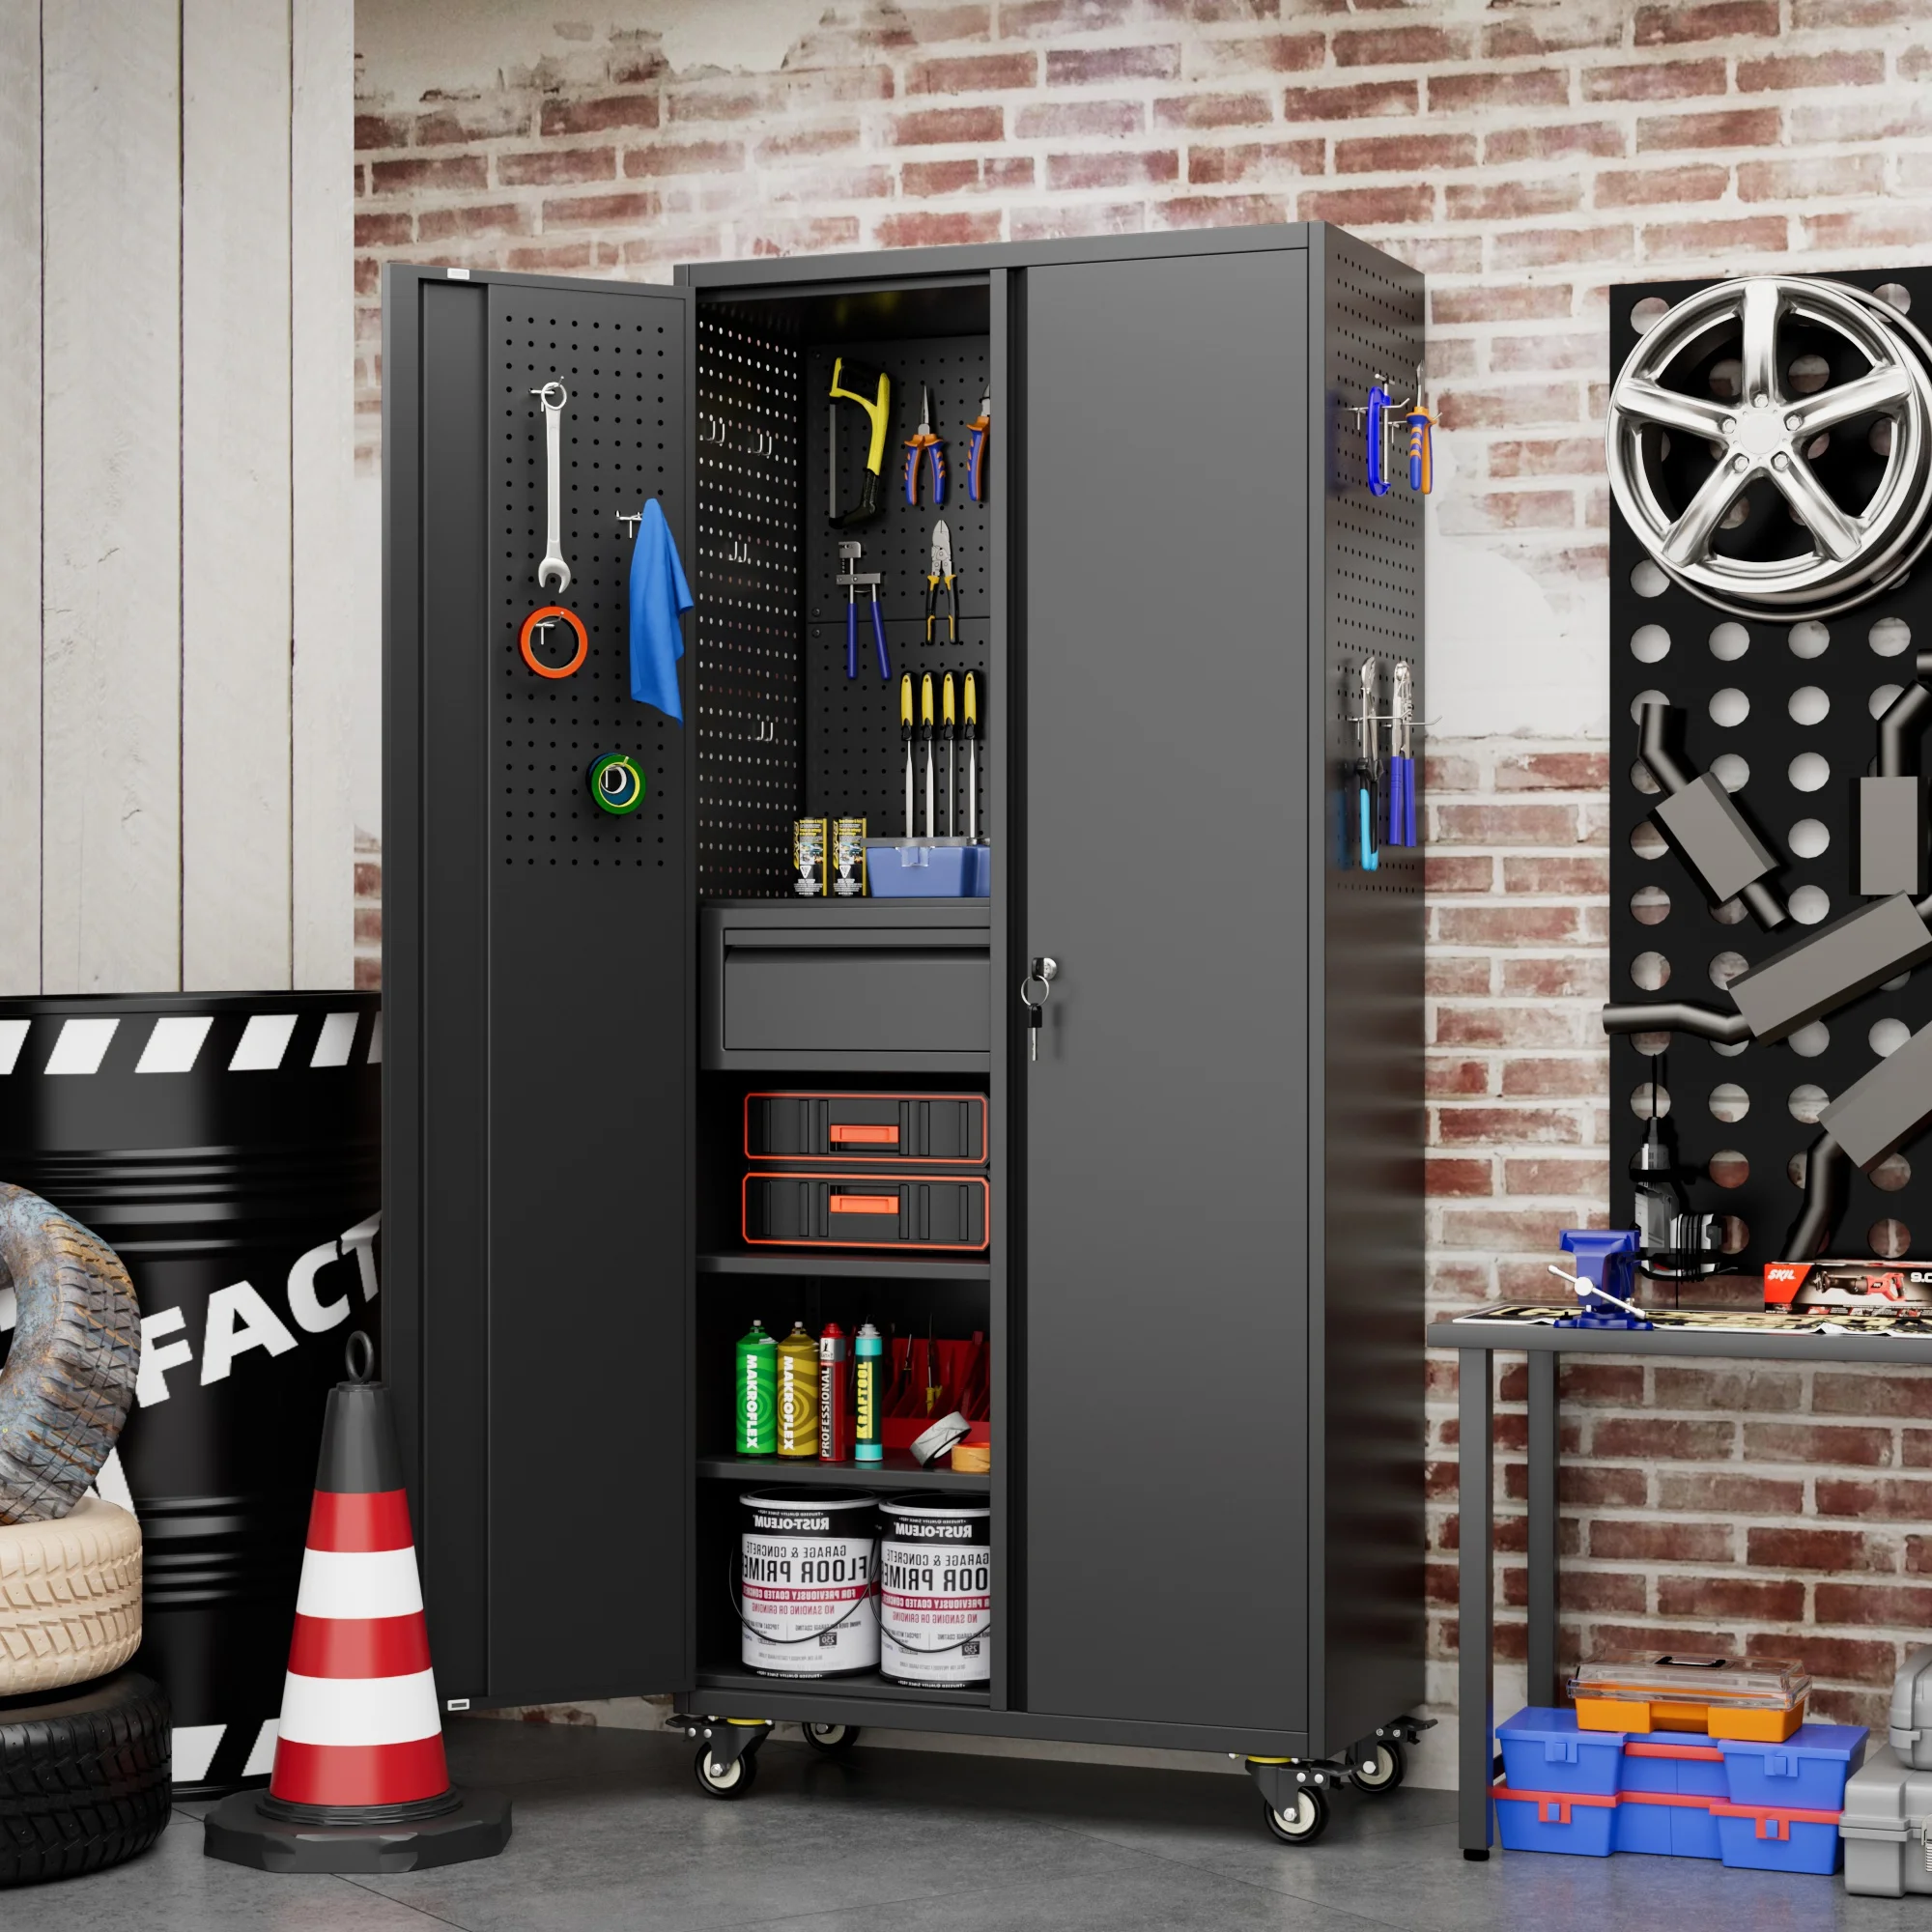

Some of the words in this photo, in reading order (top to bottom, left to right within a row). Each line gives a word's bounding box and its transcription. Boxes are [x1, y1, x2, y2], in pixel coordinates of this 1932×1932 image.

[1768, 1268, 1796, 1282] SKIL
[746, 1353, 758, 1449] MAKROFLEX
[782, 1355, 795, 1451] MAKROFLEX
[821, 1367, 831, 1457] PROFESSIONAL
[856, 1361, 868, 1439] KRAFTOOL
